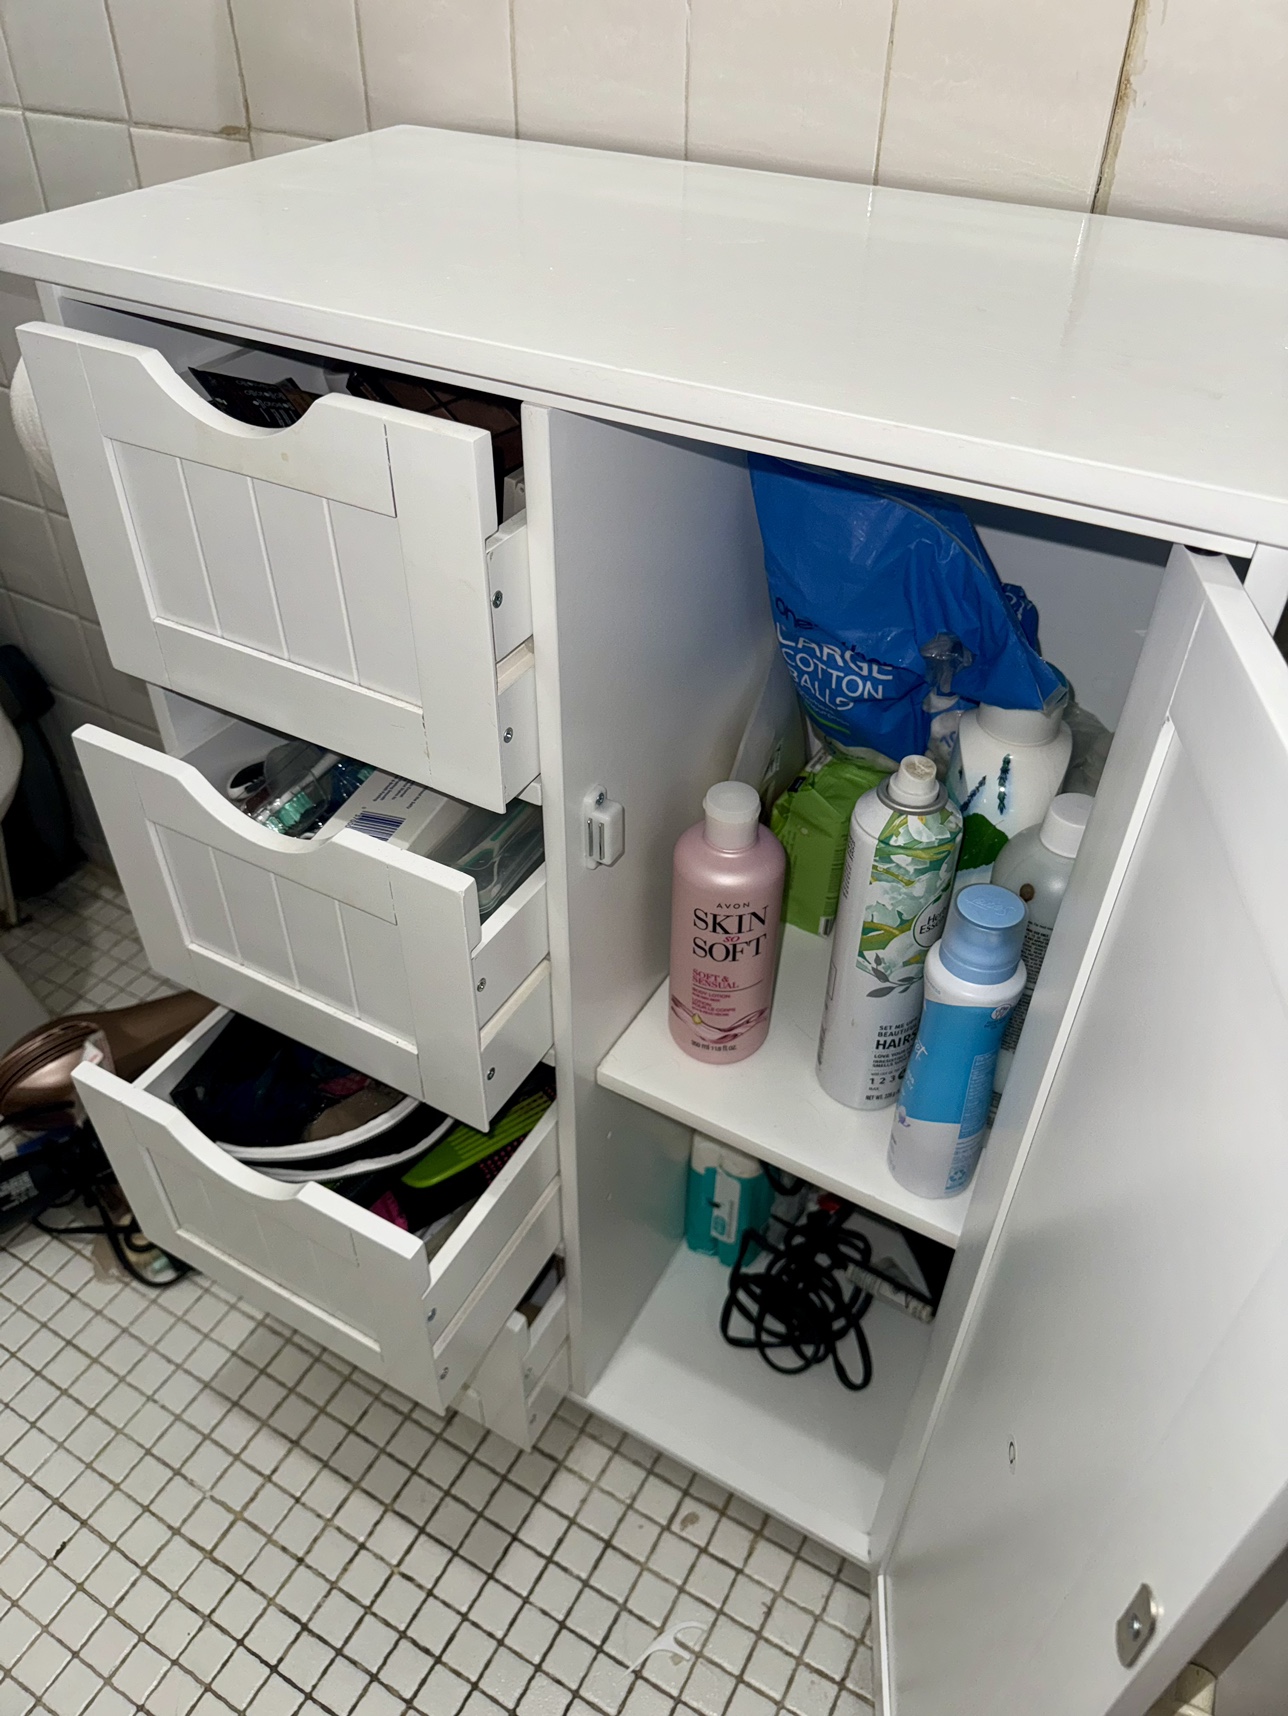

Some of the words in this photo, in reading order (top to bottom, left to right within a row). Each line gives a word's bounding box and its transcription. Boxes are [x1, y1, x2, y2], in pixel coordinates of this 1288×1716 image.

[776, 622, 893, 680] LARGE
[782, 648, 883, 700] COTTON
[716, 901, 750, 909] AVON
[693, 905, 769, 935] SKIN
[723, 935, 740, 943] so
[693, 933, 767, 962] SOFT
[692, 968, 721, 982] SOFT
[692, 976, 739, 989] SENSUAL
[875, 1031, 918, 1050] HAIRS
[879, 1077, 886, 1085] 2
[889, 1075, 896, 1083] 3
